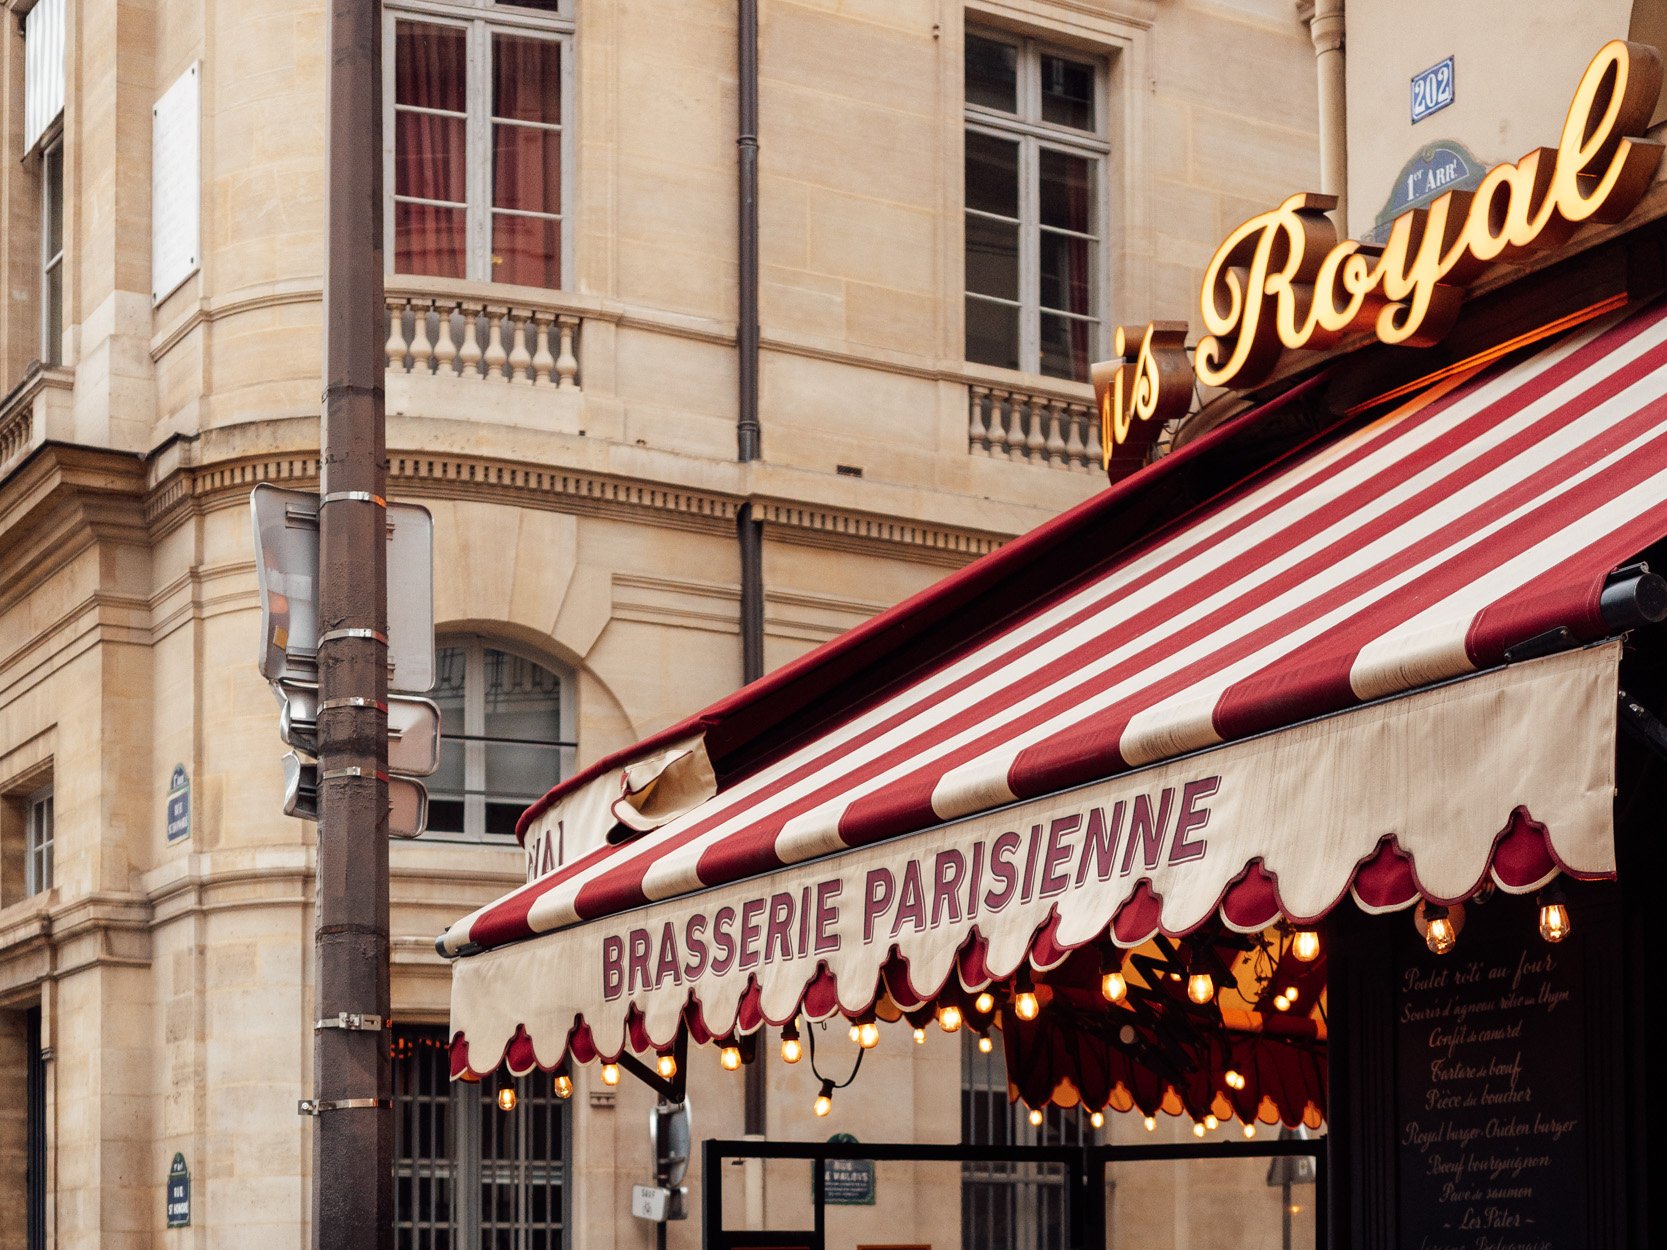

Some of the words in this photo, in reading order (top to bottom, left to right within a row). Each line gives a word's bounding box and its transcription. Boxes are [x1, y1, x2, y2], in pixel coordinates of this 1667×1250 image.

[1414, 66, 1449, 114] 202
[1195, 39, 1632, 387] Royal
[602, 878, 843, 1002] BRASSERIE
[863, 775, 1221, 945] PARISIENNE
[1402, 967, 1447, 992] Poulet
[1488, 967, 1511, 980] au
[1511, 949, 1557, 990] four
[1428, 1023, 1466, 1057] Confit
[1478, 1019, 1523, 1042] canard
[1481, 1083, 1532, 1104] boucher
[1402, 1121, 1445, 1152] Royal
[1534, 1112, 1578, 1141] burger
